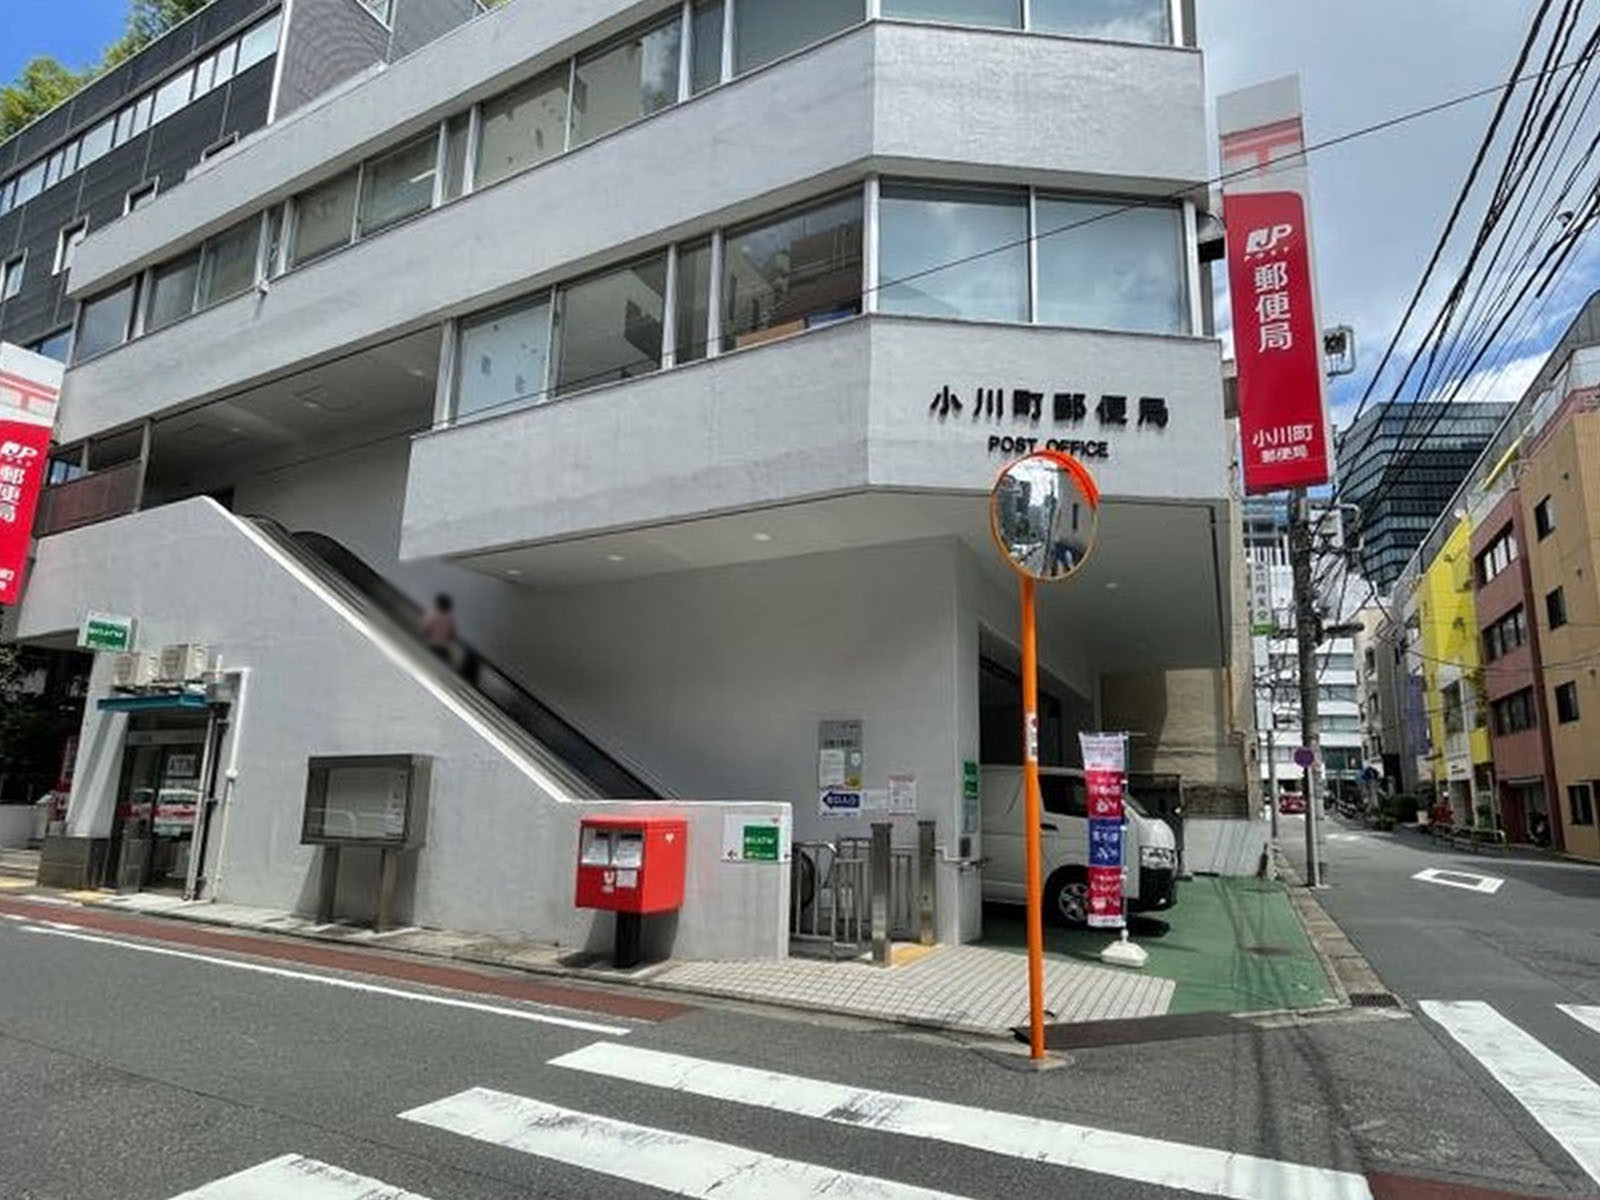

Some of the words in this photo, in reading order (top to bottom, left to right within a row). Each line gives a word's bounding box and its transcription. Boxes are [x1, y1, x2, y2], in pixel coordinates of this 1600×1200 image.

[1254, 261, 1293, 353] 郵便局
[930, 385, 1169, 428] 小川町郵便局
[988, 435, 1038, 454] POST
[1045, 438, 1109, 458] OFFICE
[1252, 424, 1314, 448] 小川町
